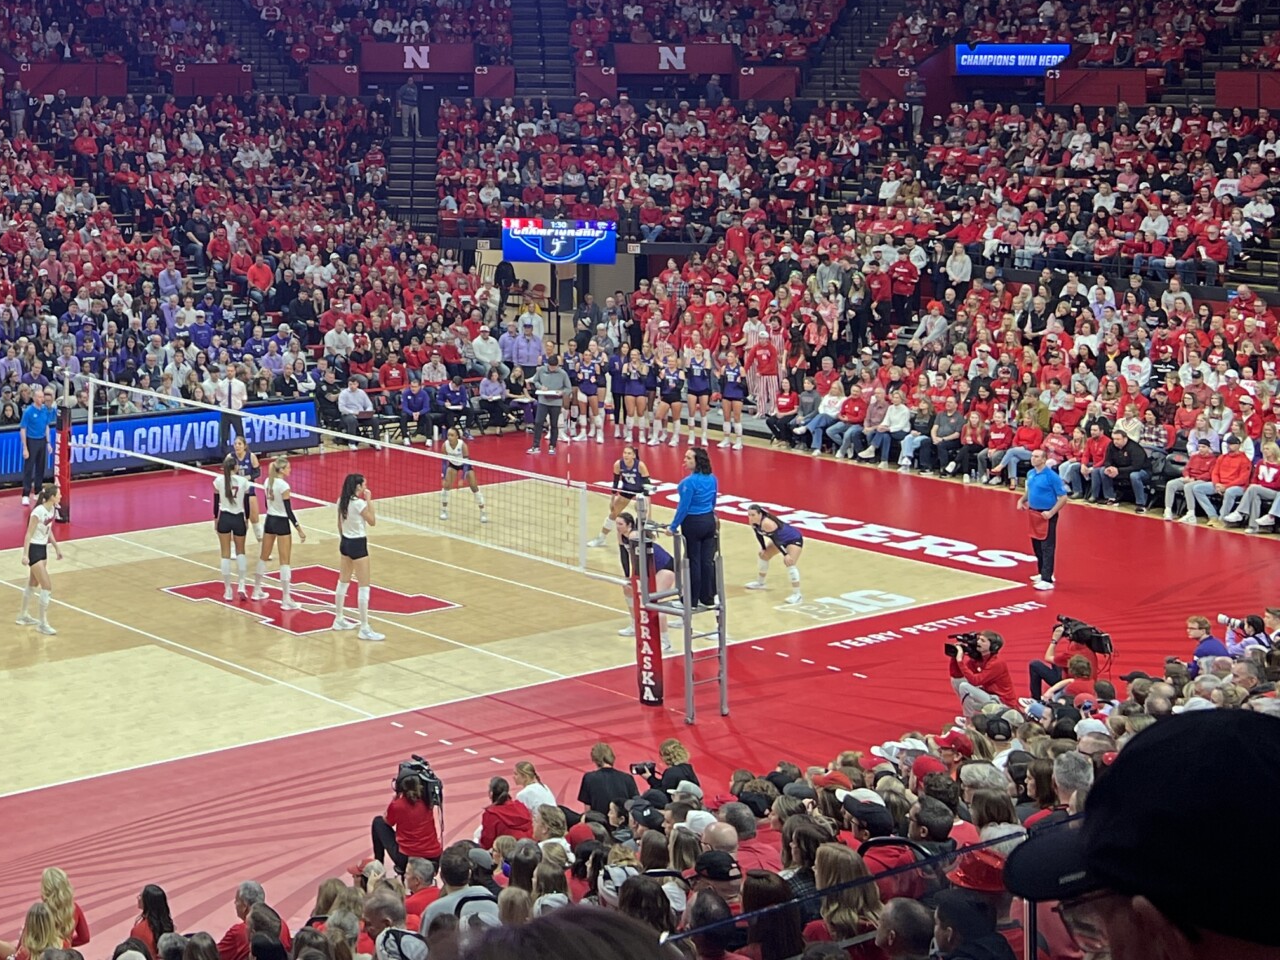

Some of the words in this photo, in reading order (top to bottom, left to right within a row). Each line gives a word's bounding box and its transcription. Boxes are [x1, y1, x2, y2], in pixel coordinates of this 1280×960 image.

[344, 65, 357, 73] C3
[403, 45, 430, 69] N
[658, 46, 686, 70] N
[961, 54, 1016, 66] CHAMPIONS
[1017, 55, 1037, 66] WIN
[475, 65, 488, 74] C3
[70, 410, 310, 464] NCAA.COM/VOEYBALL
[827, 630, 903, 650] TERRY
[900, 615, 976, 635] PETTIT
[974, 600, 1047, 619] COURT
